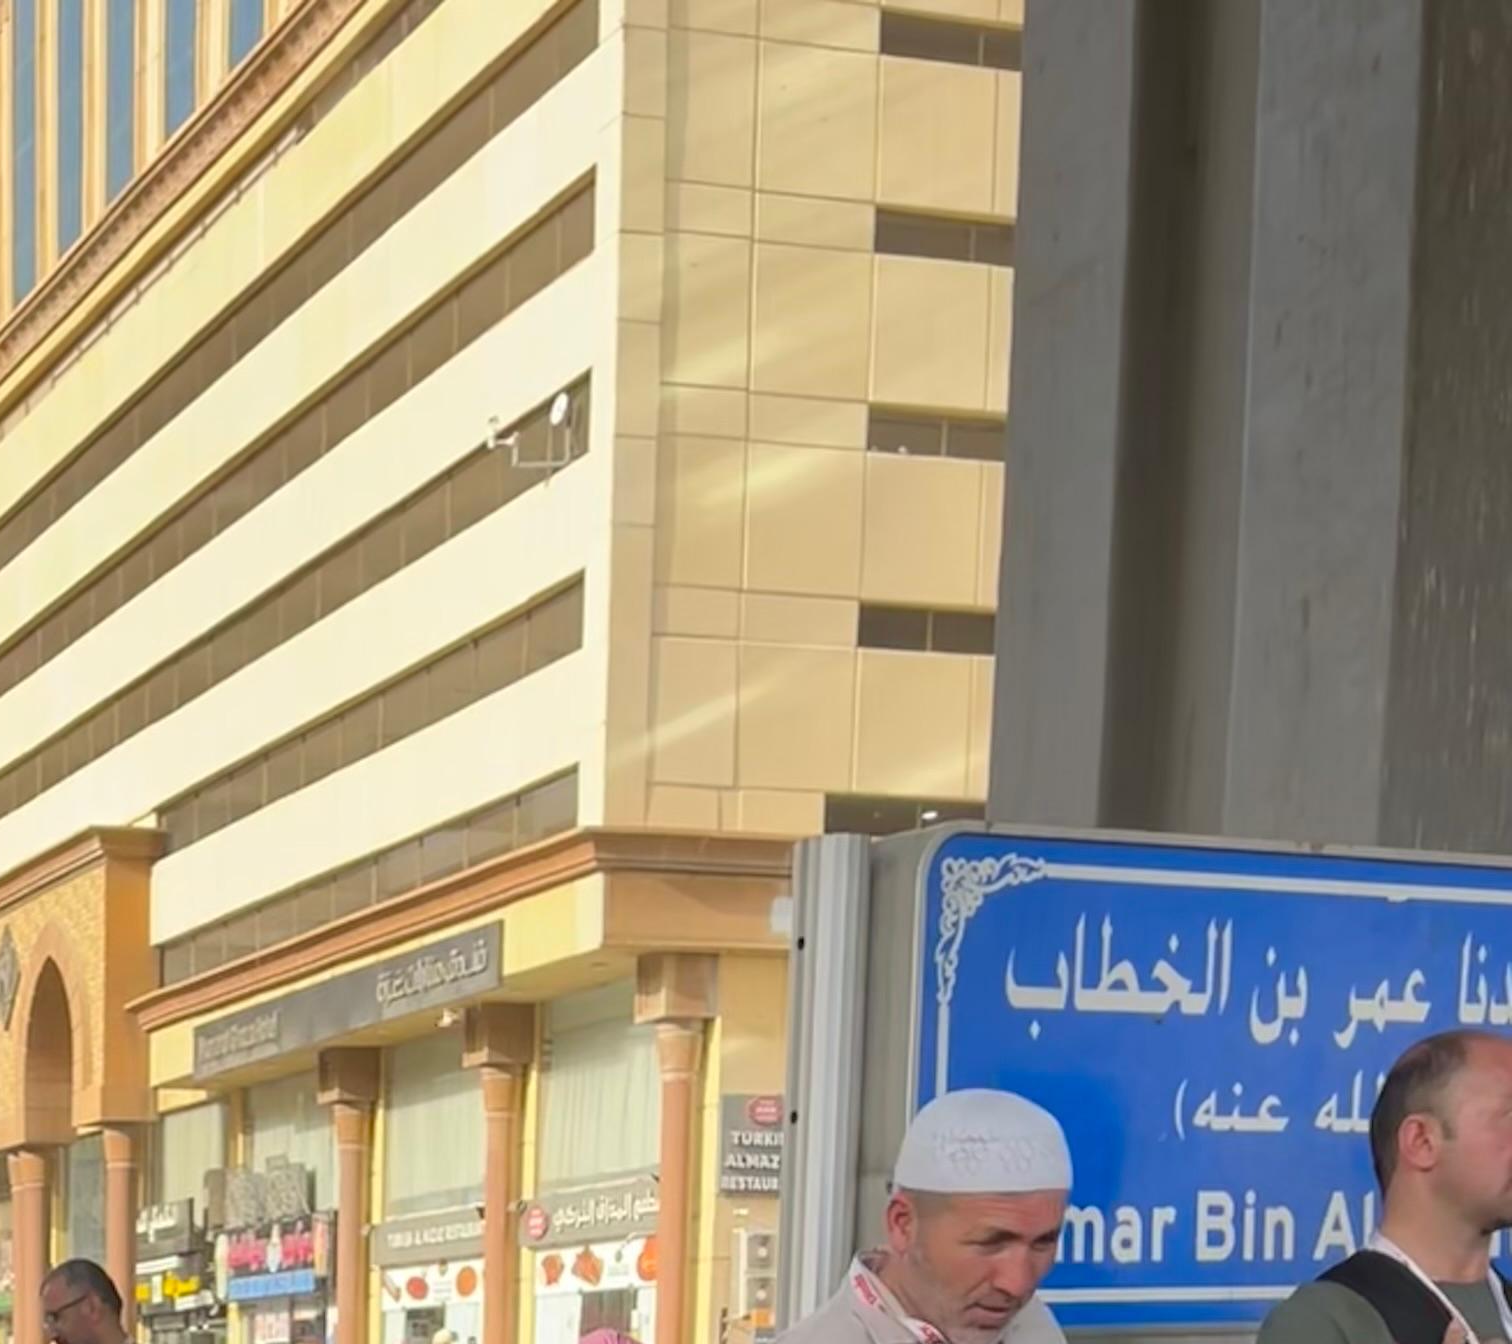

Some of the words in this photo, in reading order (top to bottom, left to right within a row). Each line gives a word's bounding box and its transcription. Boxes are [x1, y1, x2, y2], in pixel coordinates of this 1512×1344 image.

[1004, 912, 1233, 1040] الخطاب
[1249, 945, 1307, 1046] بن
[1333, 967, 1431, 1049] عمر
[1458, 930, 1512, 1025] دنا
[725, 1153, 780, 1169] ALMAZ
[730, 1130, 784, 1146] TURKI
[633, 1189, 660, 1222] طعم
[720, 1175, 778, 1190] RESTAUR
[1054, 1204, 1176, 1264] mar
[1195, 1189, 1295, 1264] Bin
